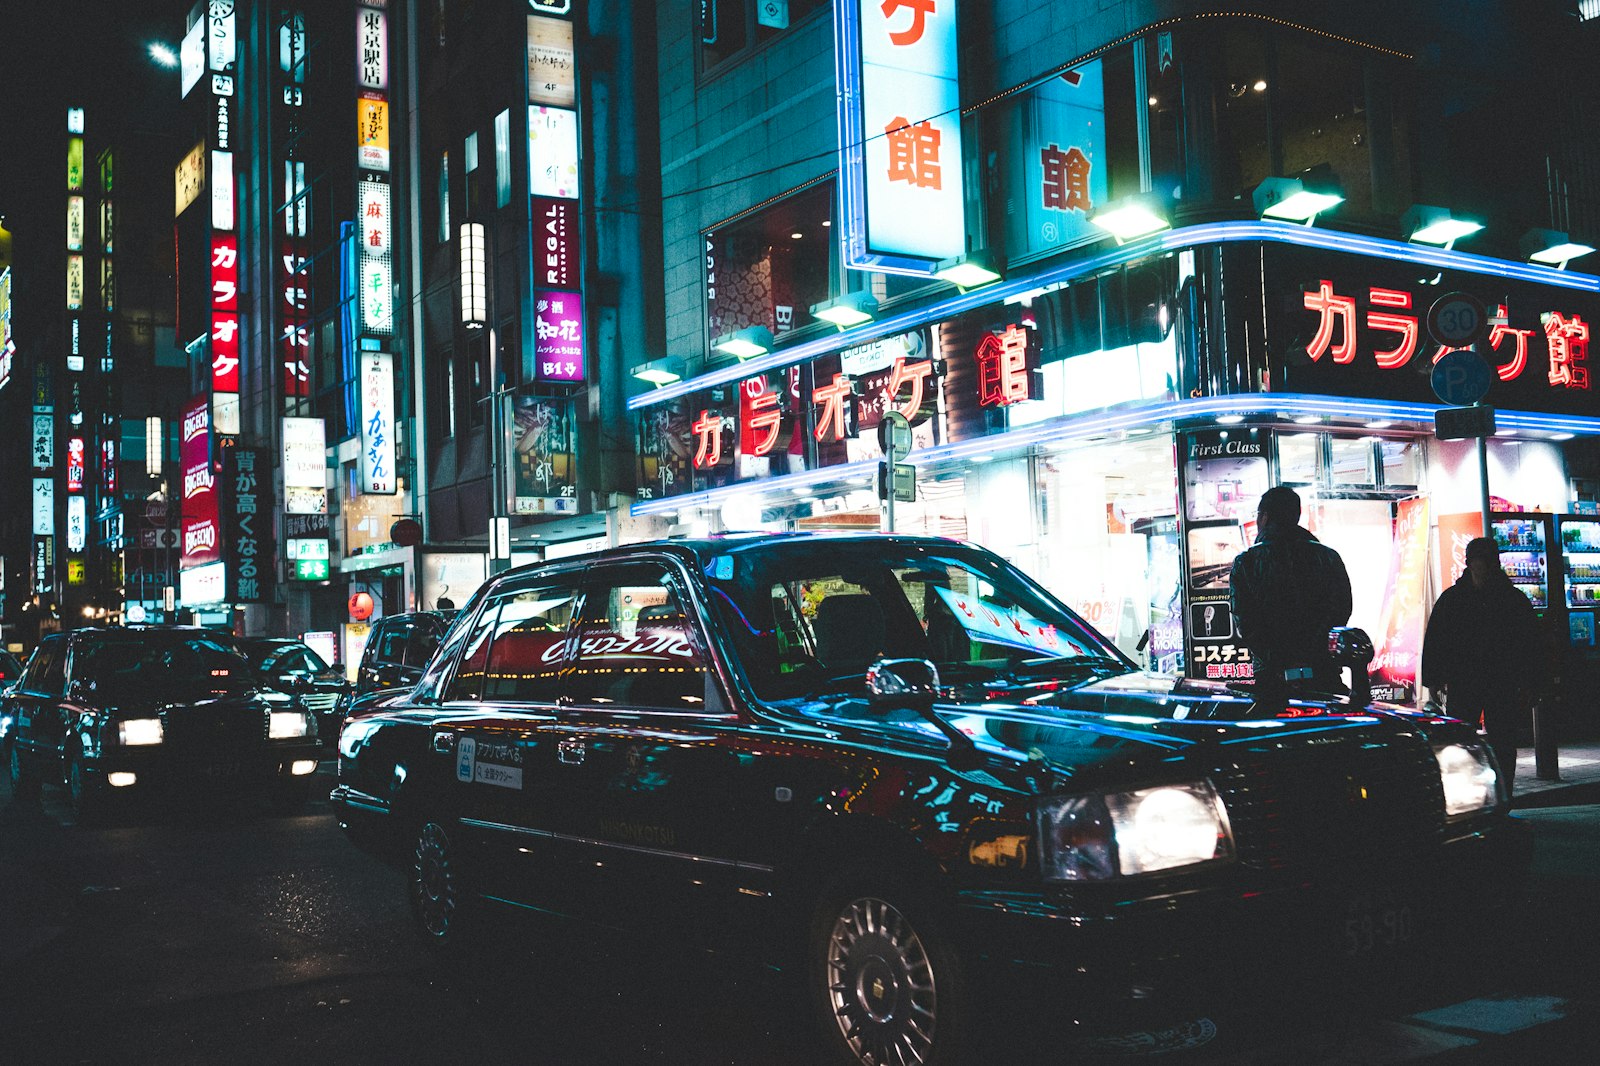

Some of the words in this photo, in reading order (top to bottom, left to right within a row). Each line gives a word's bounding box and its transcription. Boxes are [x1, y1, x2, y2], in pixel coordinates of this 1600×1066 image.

[364, 12, 380, 85] 東京駅店
[545, 83, 557, 91] 4F
[366, 202, 383, 248] 麻雀
[546, 204, 558, 284] REGAL
[212, 245, 239, 377] カラオケ
[1443, 308, 1474, 333] 30
[536, 314, 581, 341] 知花
[1303, 279, 1592, 390] カラケ館
[543, 361, 562, 376] B1
[1446, 366, 1467, 399] P
[692, 323, 1032, 471] カラオケ館
[195, 410, 208, 429] ECH
[368, 410, 388, 478] かあさん
[1190, 442, 1223, 457] First
[1225, 440, 1261, 454] Class
[185, 474, 197, 500] BIG
[372, 482, 387, 491] B1
[561, 486, 575, 497] 2F
[235, 450, 260, 600] 背が高くなる靴
[185, 530, 197, 556] BIG
[197, 524, 215, 548] ECHO
[1206, 662, 1254, 678] 無料貸
[460, 743, 475, 754] TAXI
